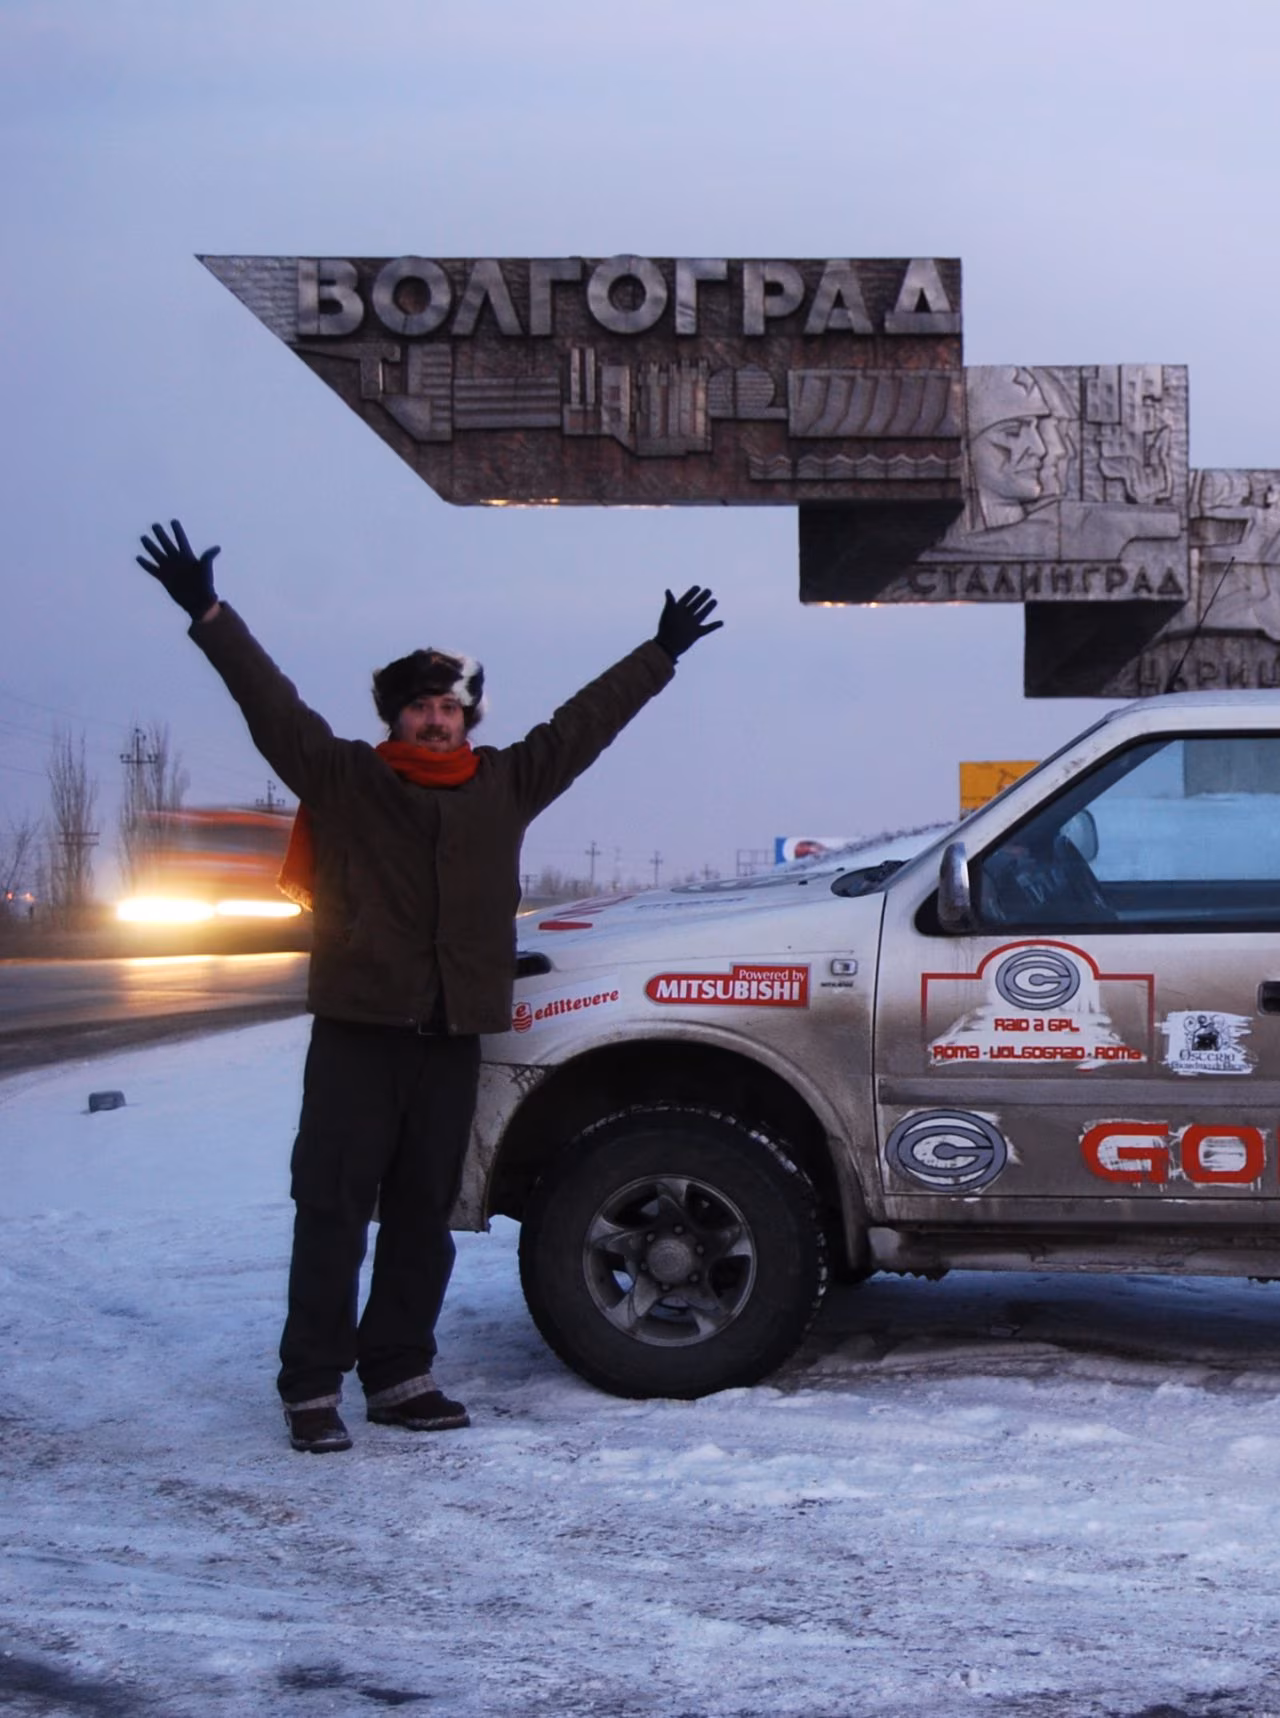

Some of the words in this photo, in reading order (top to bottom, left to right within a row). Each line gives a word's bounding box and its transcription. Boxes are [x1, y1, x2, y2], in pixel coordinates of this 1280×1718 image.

[298, 254, 961, 336] ВОЛГОГРАД
[909, 566, 1185, 595] СТАЛИНГРАД
[739, 969, 787, 982] Powered
[792, 970, 806, 983] by
[655, 979, 801, 1002] MITSUBISHI
[533, 988, 620, 1023] ediltevere
[1047, 1018, 1081, 1032] GPL
